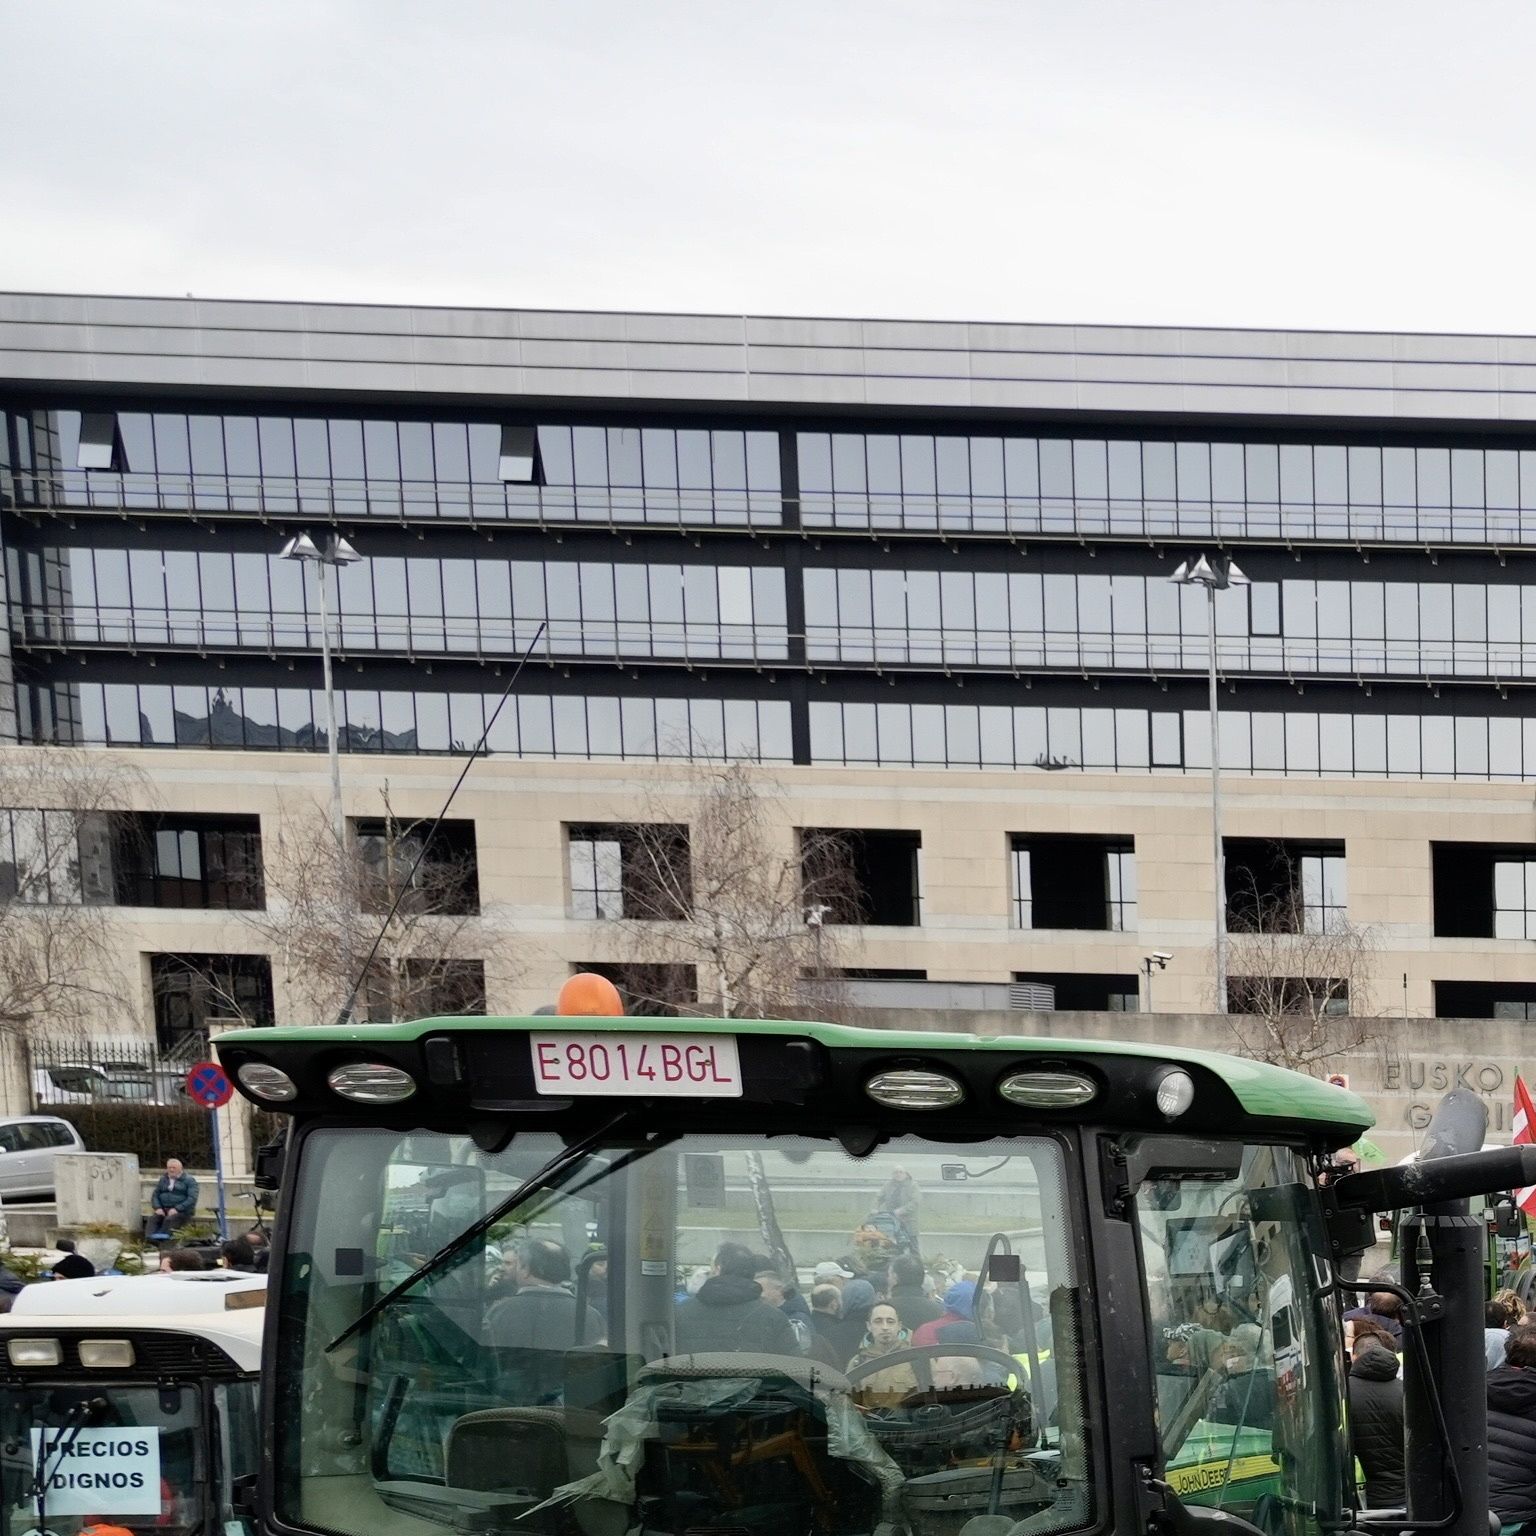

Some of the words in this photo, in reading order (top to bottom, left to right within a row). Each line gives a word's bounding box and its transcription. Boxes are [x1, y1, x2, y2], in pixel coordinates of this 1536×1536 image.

[1384, 1061, 1503, 1093] EUSKO
[45, 1440, 149, 1458] PRECIOS
[53, 1472, 144, 1489] DIGNOS
[1178, 1471, 1202, 1494] JOHN
